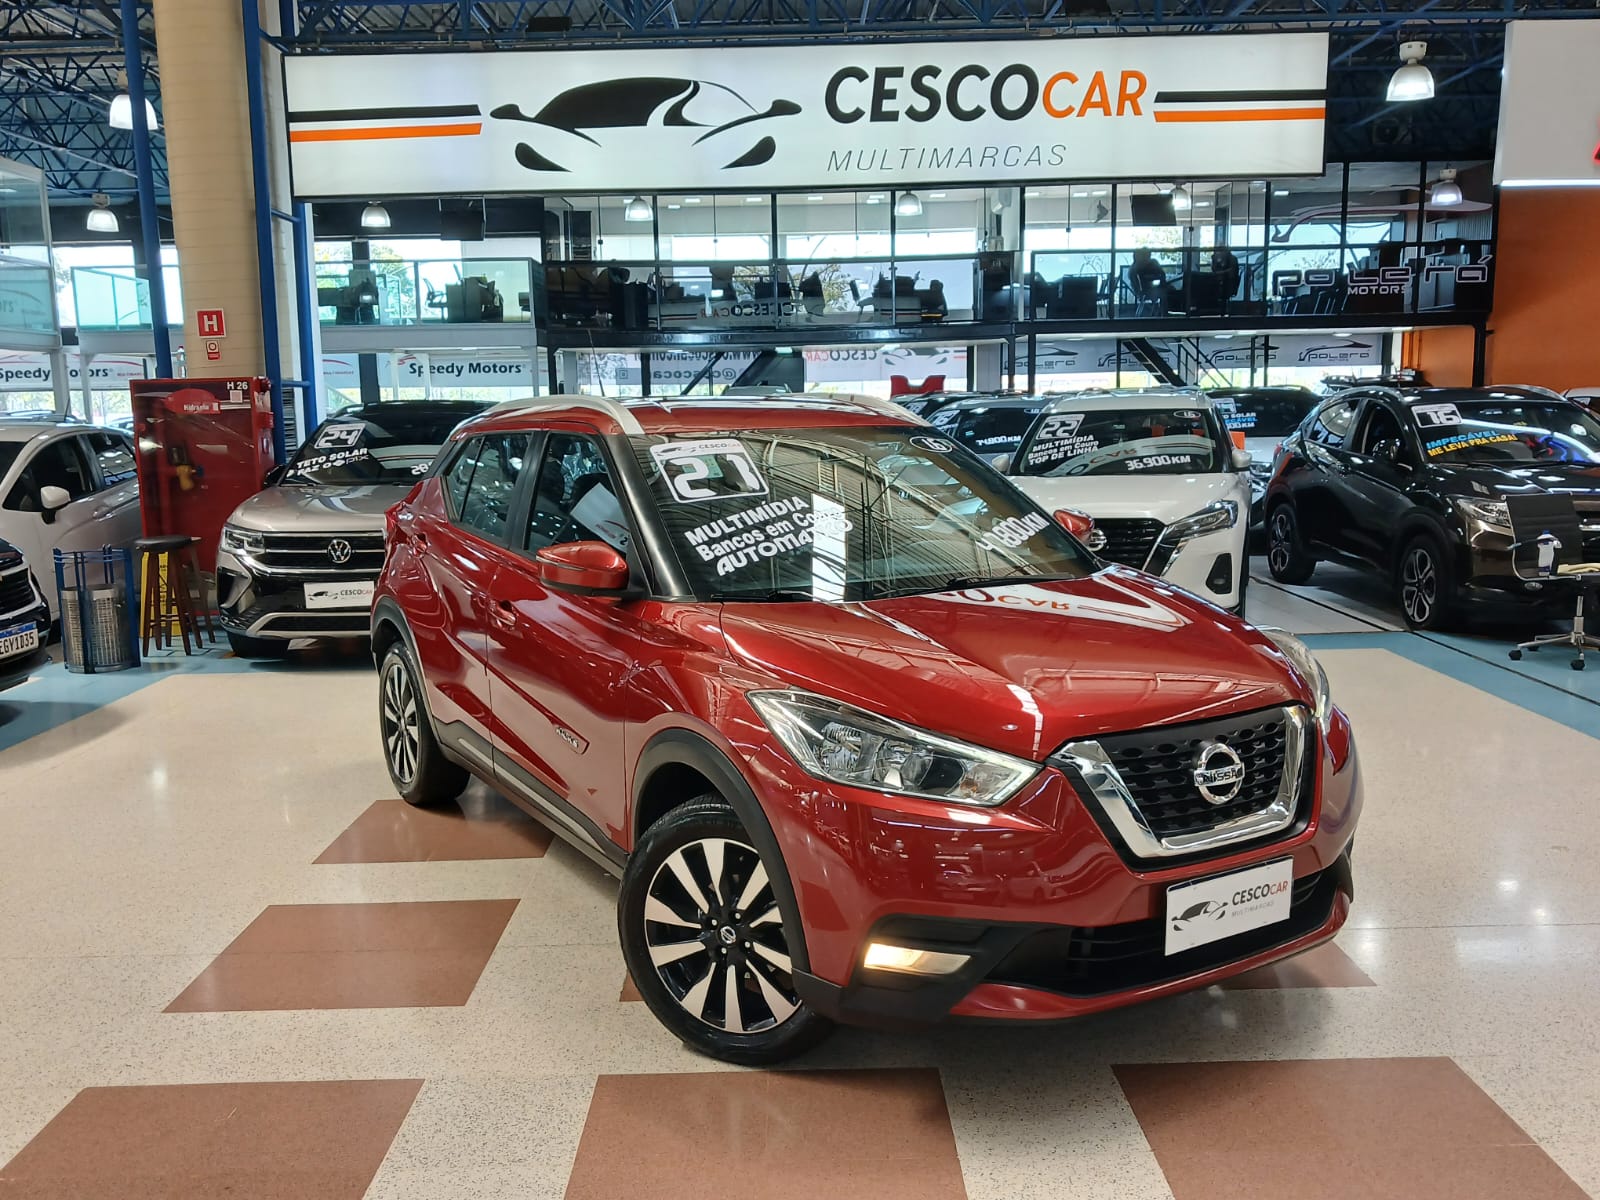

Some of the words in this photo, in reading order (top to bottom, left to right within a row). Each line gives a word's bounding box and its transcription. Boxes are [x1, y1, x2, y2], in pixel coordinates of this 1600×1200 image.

[825, 63, 1147, 124] CESCOCAR
[827, 144, 1067, 172] MULTIMARCAS
[1347, 286, 1406, 295] MOTORS
[203, 314, 219, 332] H
[409, 363, 464, 377] Speedy
[468, 363, 522, 374] Motors
[237, 381, 248, 390] 26
[1427, 410, 1459, 424] 16
[318, 429, 358, 447] 24
[1040, 419, 1078, 438] 22
[1028, 447, 1058, 460] Bancos
[1028, 455, 1049, 465] TOP
[1051, 452, 1065, 461] DE
[1066, 445, 1099, 457] LINHA
[1427, 447, 1444, 456] ME
[1444, 441, 1469, 452] LEVA
[1469, 436, 1490, 447] PRA
[1489, 434, 1519, 443] CASA!
[296, 456, 327, 469] TETO
[329, 448, 368, 462] SOLAR
[669, 454, 760, 498] 21
[684, 496, 809, 546] MULTIMÍDIA
[695, 529, 765, 562] Bancos
[766, 520, 795, 537] em
[1232, 880, 1289, 906] CESCOCAR
